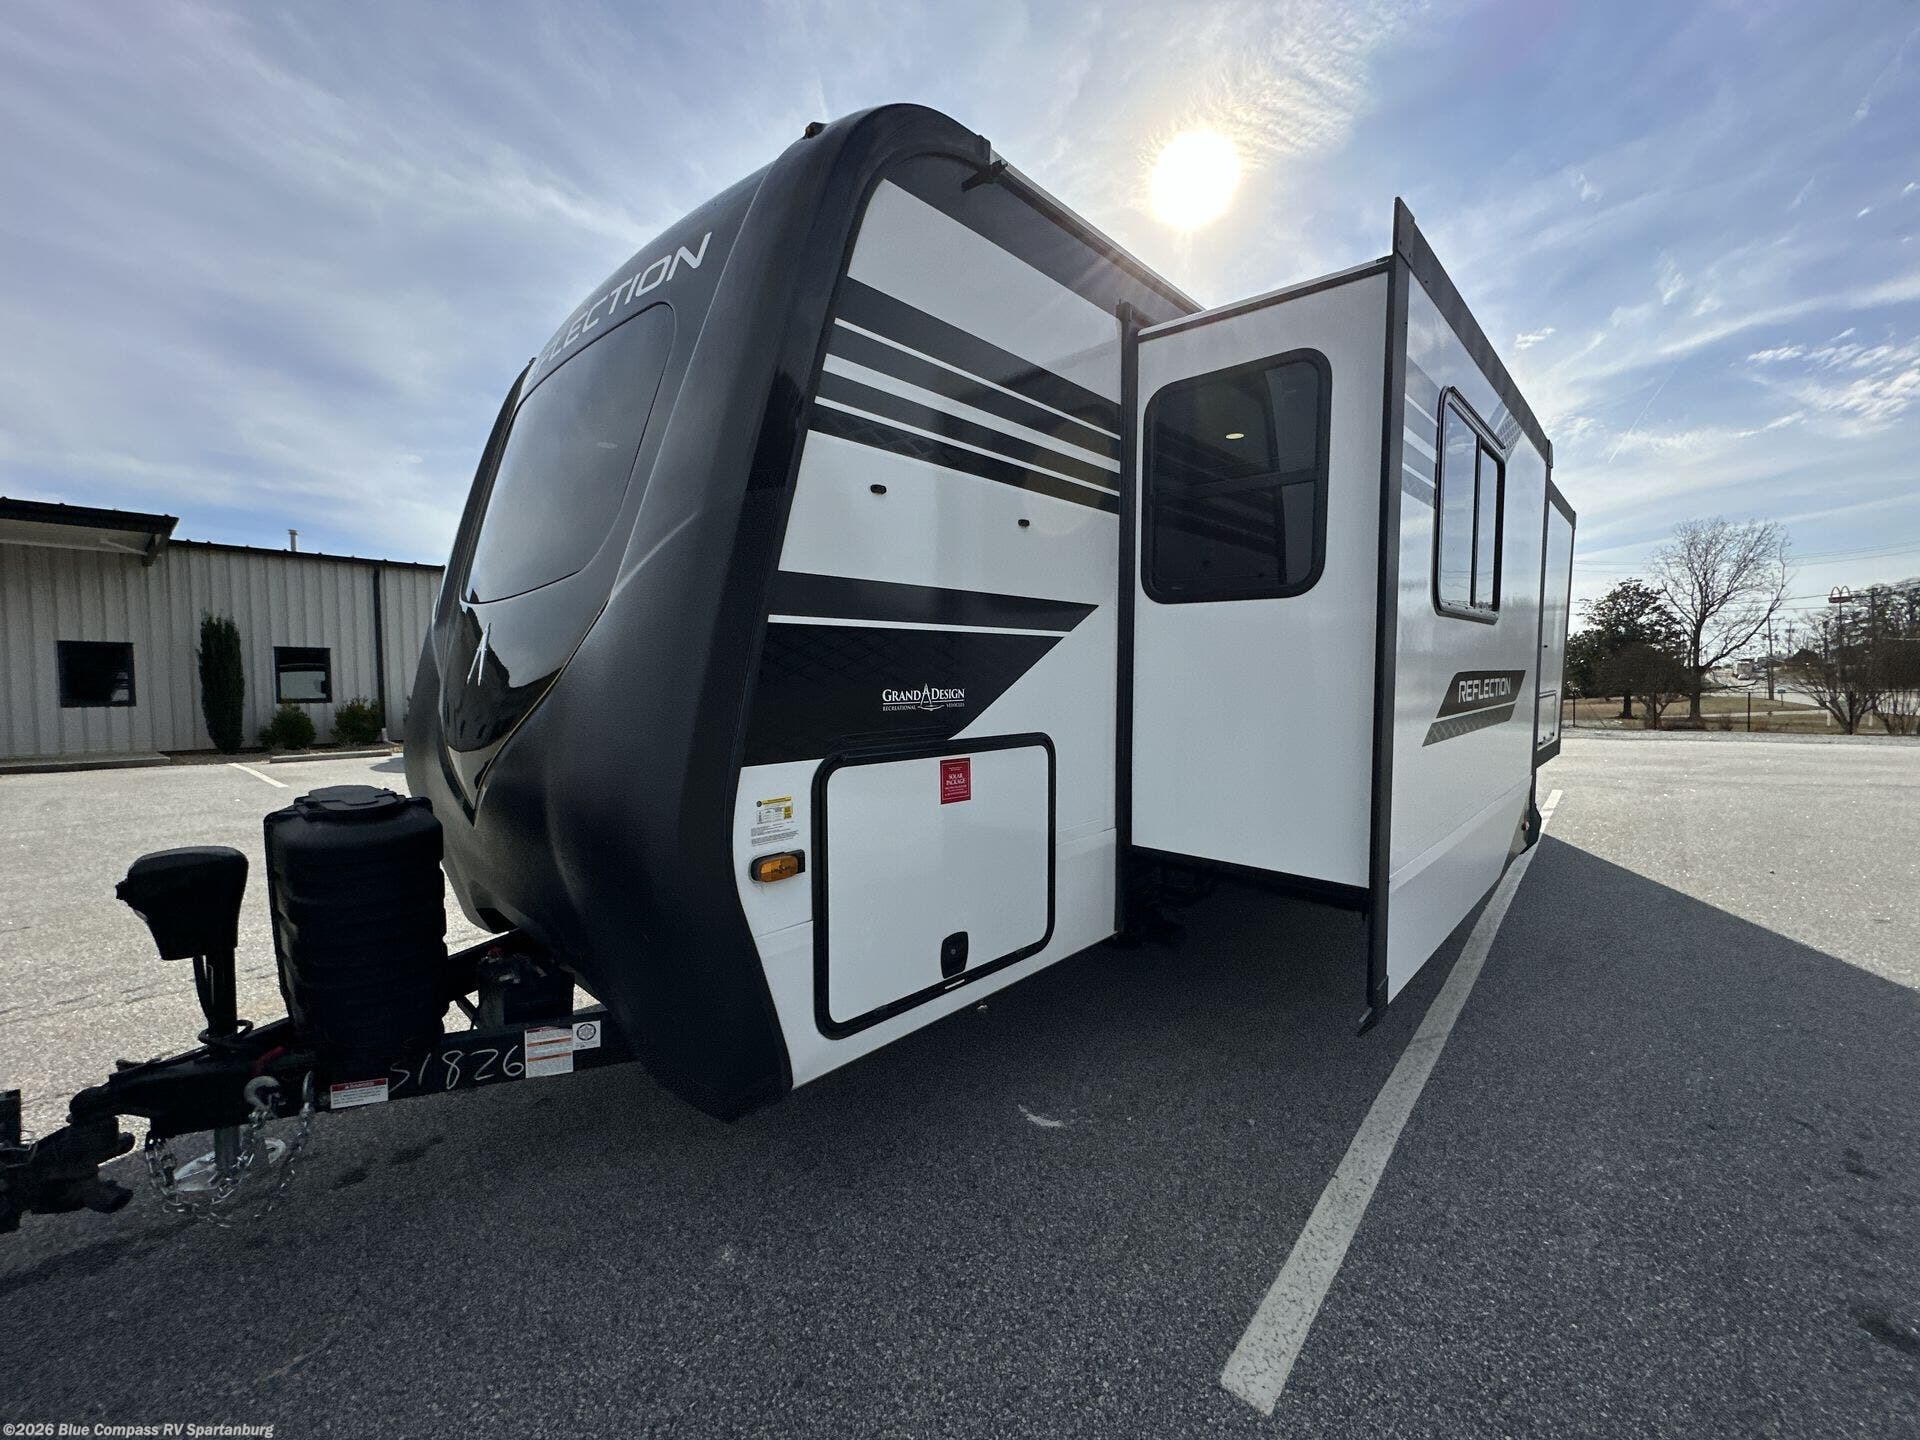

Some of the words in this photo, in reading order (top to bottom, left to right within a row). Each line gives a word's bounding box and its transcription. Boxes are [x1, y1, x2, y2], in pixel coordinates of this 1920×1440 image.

[882, 688, 921, 702] GRAND
[931, 687, 965, 699] DESIGN
[1458, 677, 1512, 703] REFLECTION
